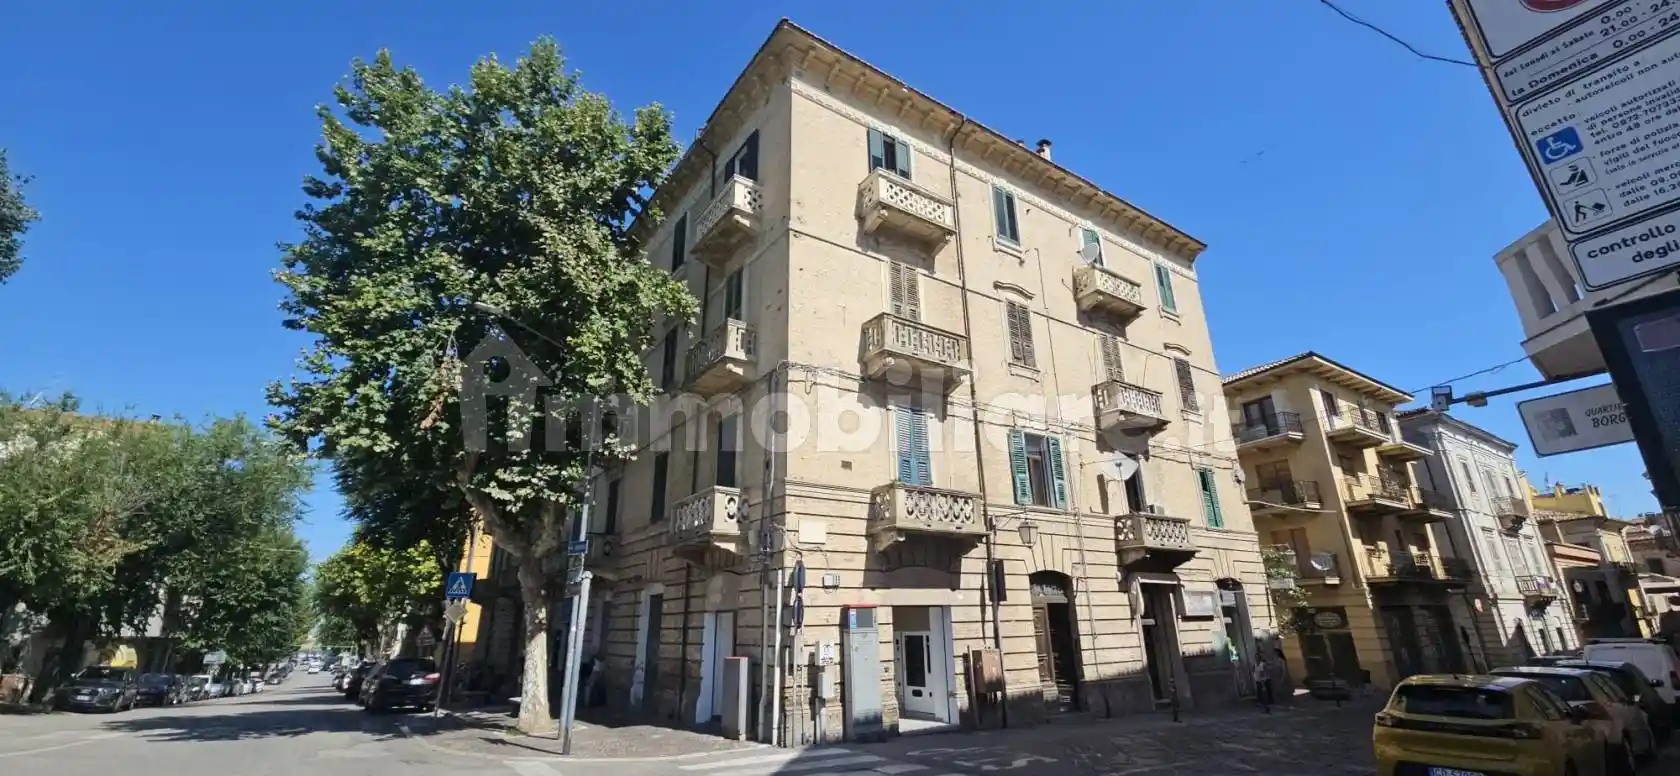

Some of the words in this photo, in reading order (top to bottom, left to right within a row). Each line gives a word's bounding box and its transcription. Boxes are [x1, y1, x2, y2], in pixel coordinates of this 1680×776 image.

[1599, 15, 1638, 38] 21.00
[1650, 0, 1680, 12] 24.
[1600, 6, 1633, 25] 0.00
[1503, 68, 1518, 78] dal
[1562, 30, 1595, 49] Sabato
[1527, 51, 1600, 89] Domenica
[1612, 30, 1647, 49] 0.00
[1521, 96, 1561, 118] divieto
[1564, 89, 1575, 99] di
[1582, 65, 1630, 90] transito
[1574, 72, 1635, 104] autoveicoli
[1637, 63, 1659, 76] non
[1661, 51, 1680, 65] aut
[1584, 105, 1618, 124] veicoli
[1620, 80, 1677, 108] autorizzati
[1586, 122, 1597, 131] di
[1600, 103, 1643, 126] persone
[1593, 130, 1623, 145] entro
[1644, 113, 1662, 125] ore
[1599, 142, 1627, 158] forze
[1629, 136, 1641, 146] di
[1603, 151, 1630, 167] vigili
[1632, 143, 1651, 155] del
[1615, 172, 1650, 190] veicoli
[1619, 182, 1647, 199] dalle
[1623, 194, 1651, 207] dalle
[1587, 224, 1676, 259] controllo
[1631, 240, 1680, 263] degli
[1592, 413, 1626, 428] BORG
